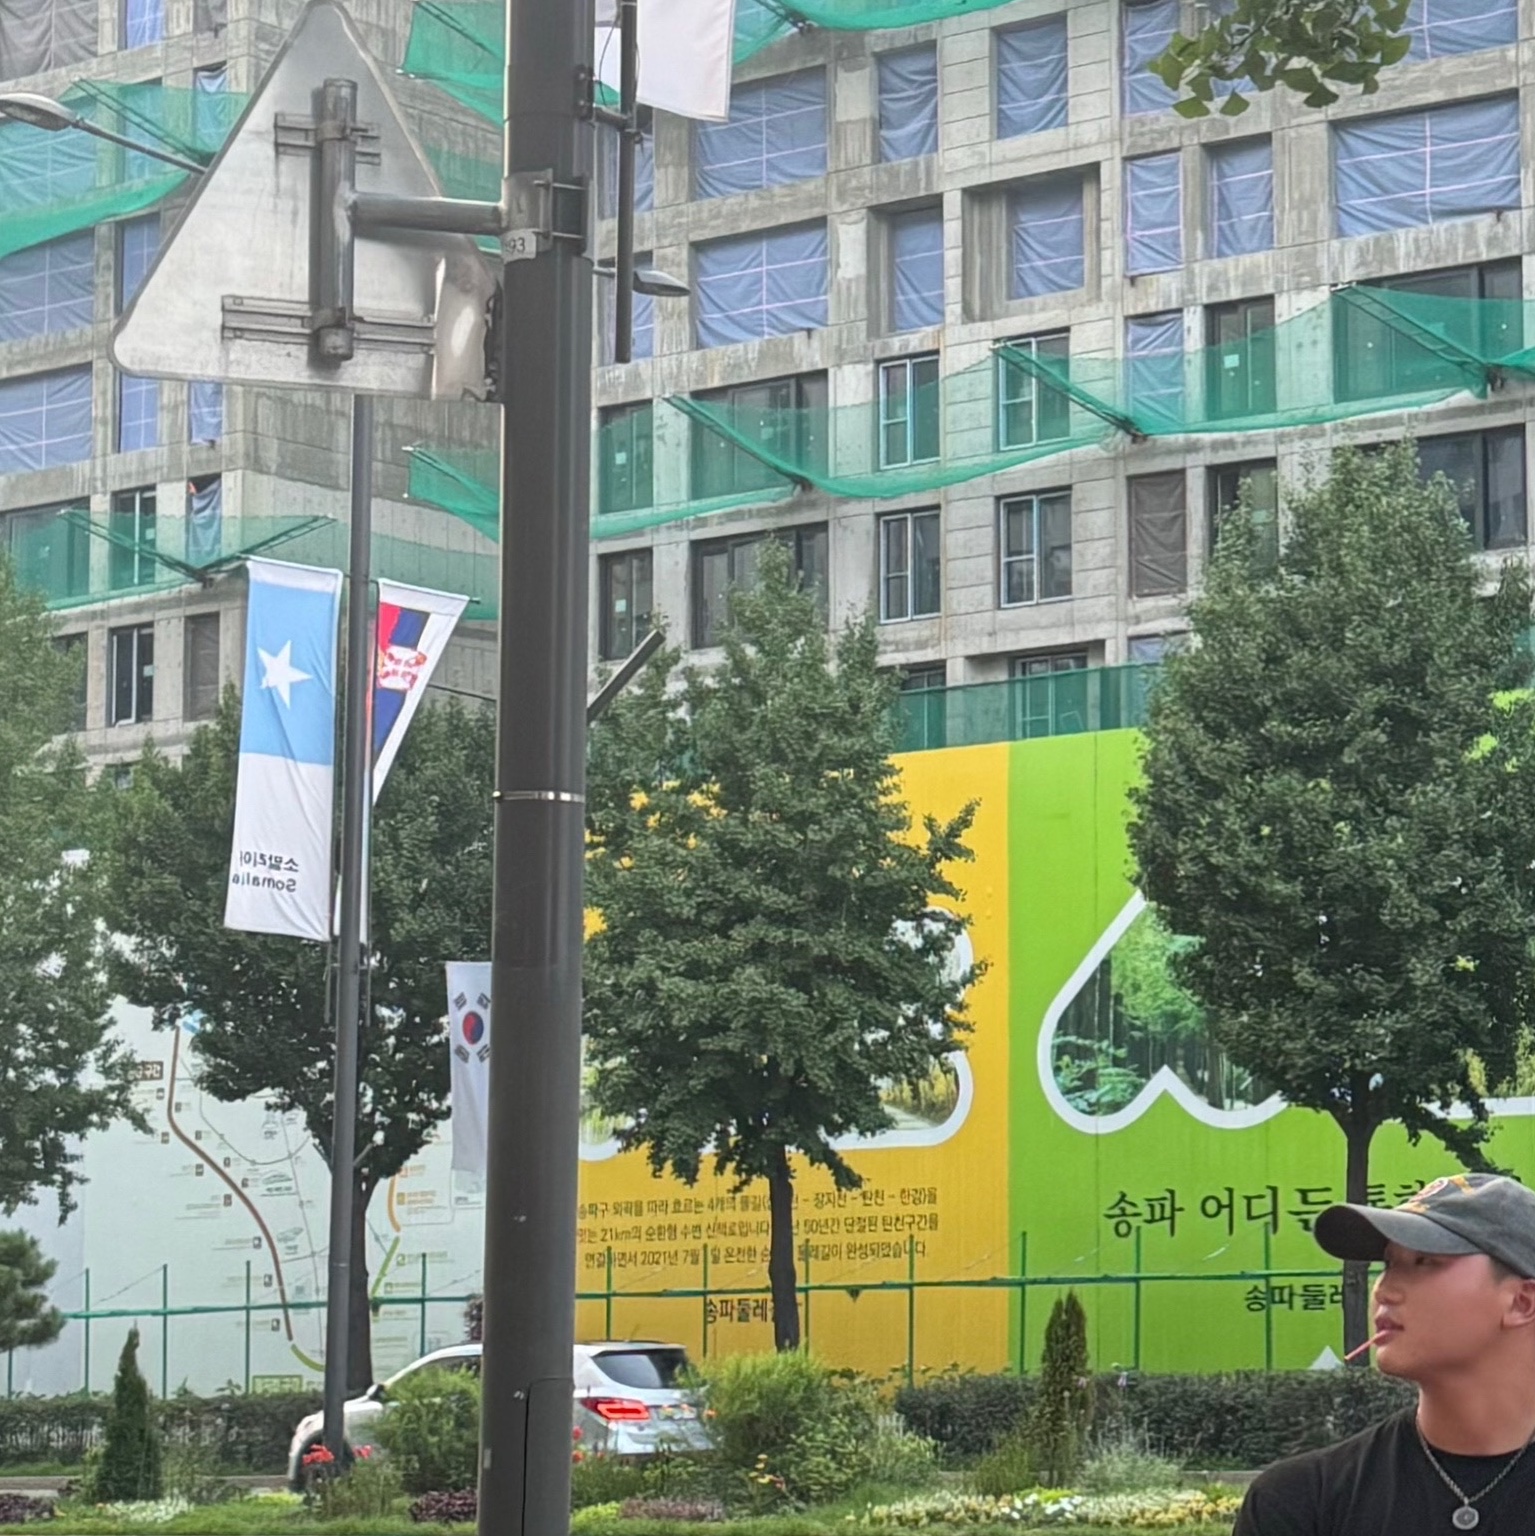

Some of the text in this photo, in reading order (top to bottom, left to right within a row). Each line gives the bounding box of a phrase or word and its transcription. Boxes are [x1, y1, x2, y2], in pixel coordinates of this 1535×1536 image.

[647, 1198, 669, 1216] 따라
[671, 1198, 704, 1215] 흐르는
[1103, 1188, 1184, 1238] 송파
[641, 1250, 679, 1266] 2021년
[707, 1298, 775, 1324] 송파둘레
